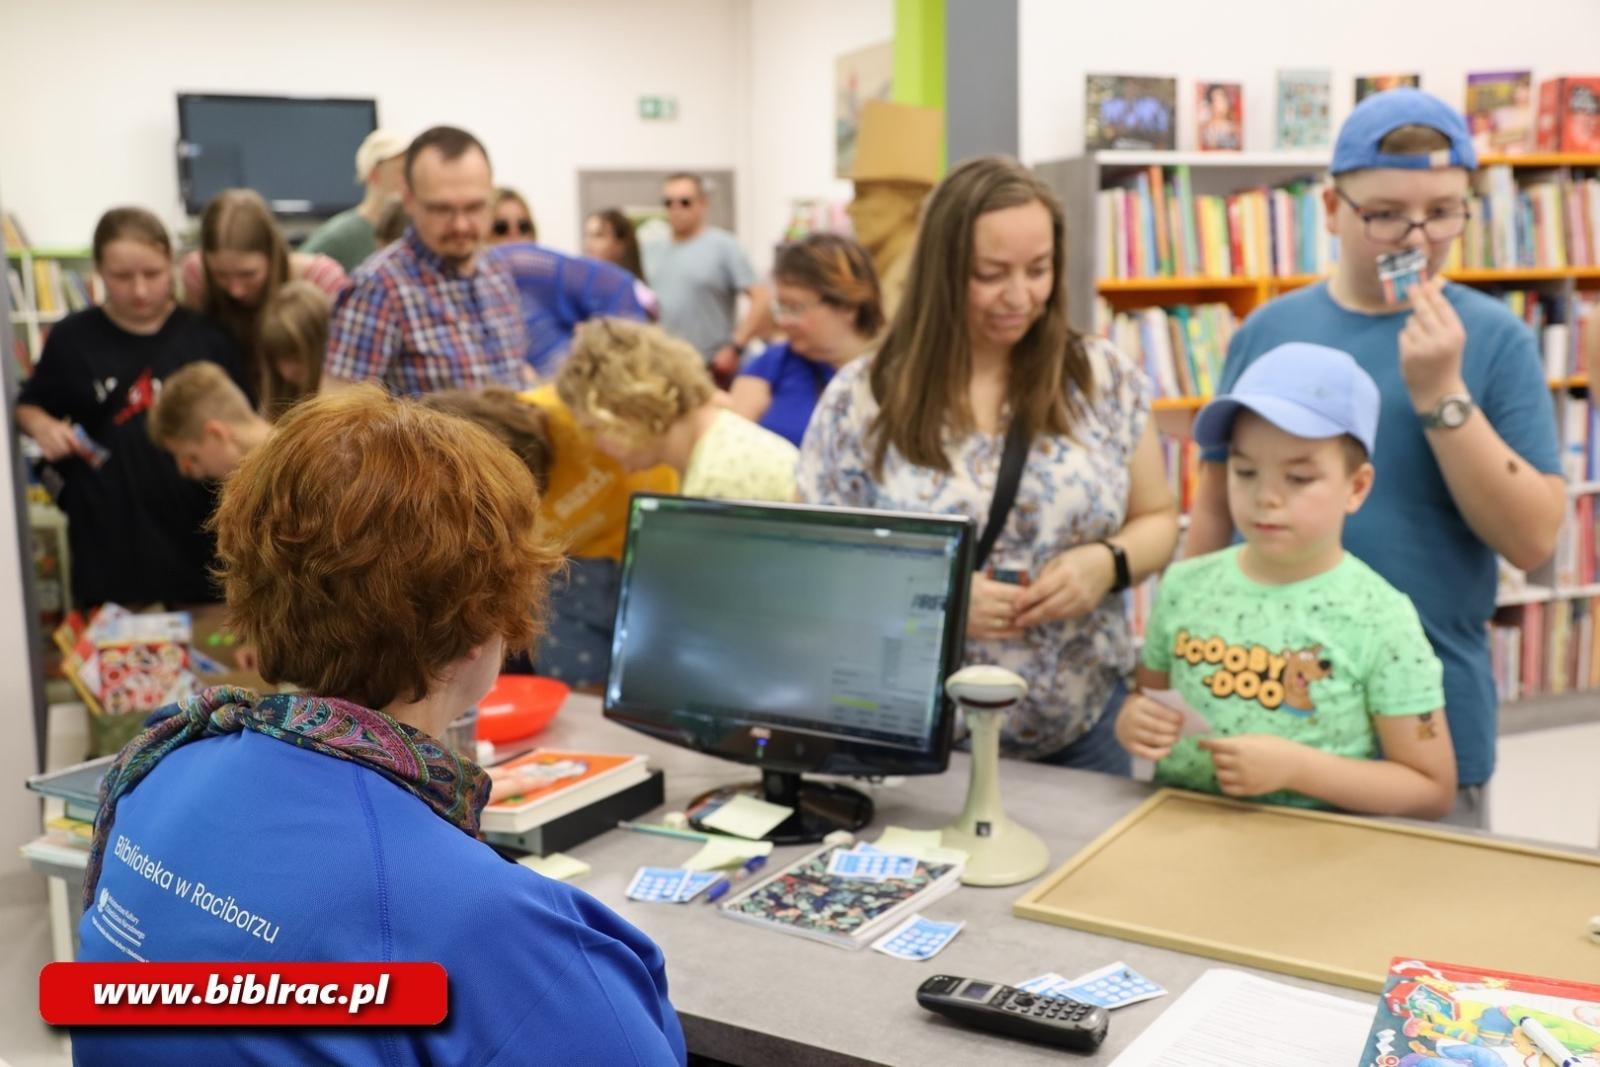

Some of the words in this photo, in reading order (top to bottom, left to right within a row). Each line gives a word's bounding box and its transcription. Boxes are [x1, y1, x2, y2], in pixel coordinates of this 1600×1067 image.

[1174, 628, 1287, 680] SCOOBY
[114, 834, 174, 890] Biblioteka
[175, 876, 192, 898] w
[190, 882, 280, 944] Raciborzu
